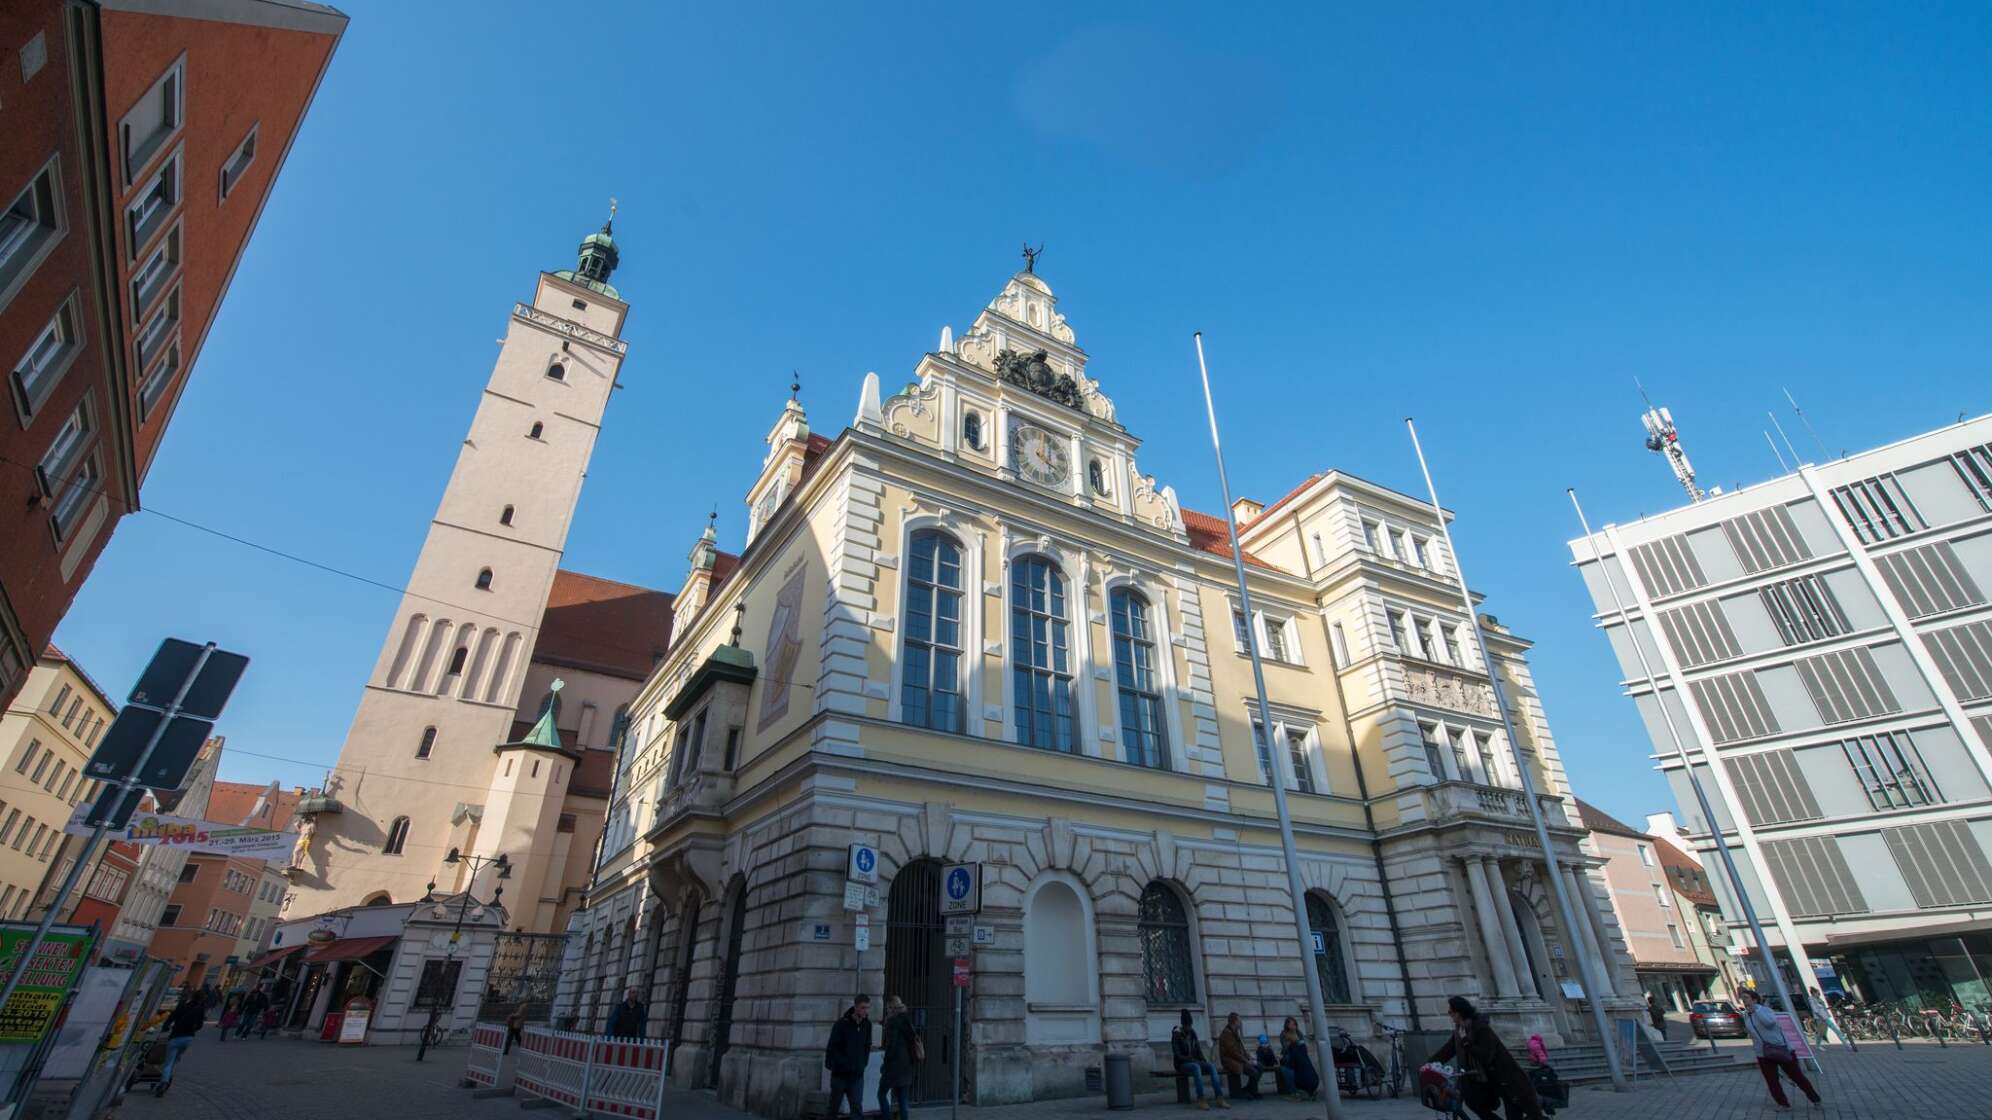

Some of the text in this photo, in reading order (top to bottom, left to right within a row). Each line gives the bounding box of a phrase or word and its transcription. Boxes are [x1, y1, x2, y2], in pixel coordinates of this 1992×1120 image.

[159, 831, 210, 845] 2015
[239, 835, 259, 844] März
[261, 833, 281, 842] 2015
[948, 901, 967, 909] ZONE
